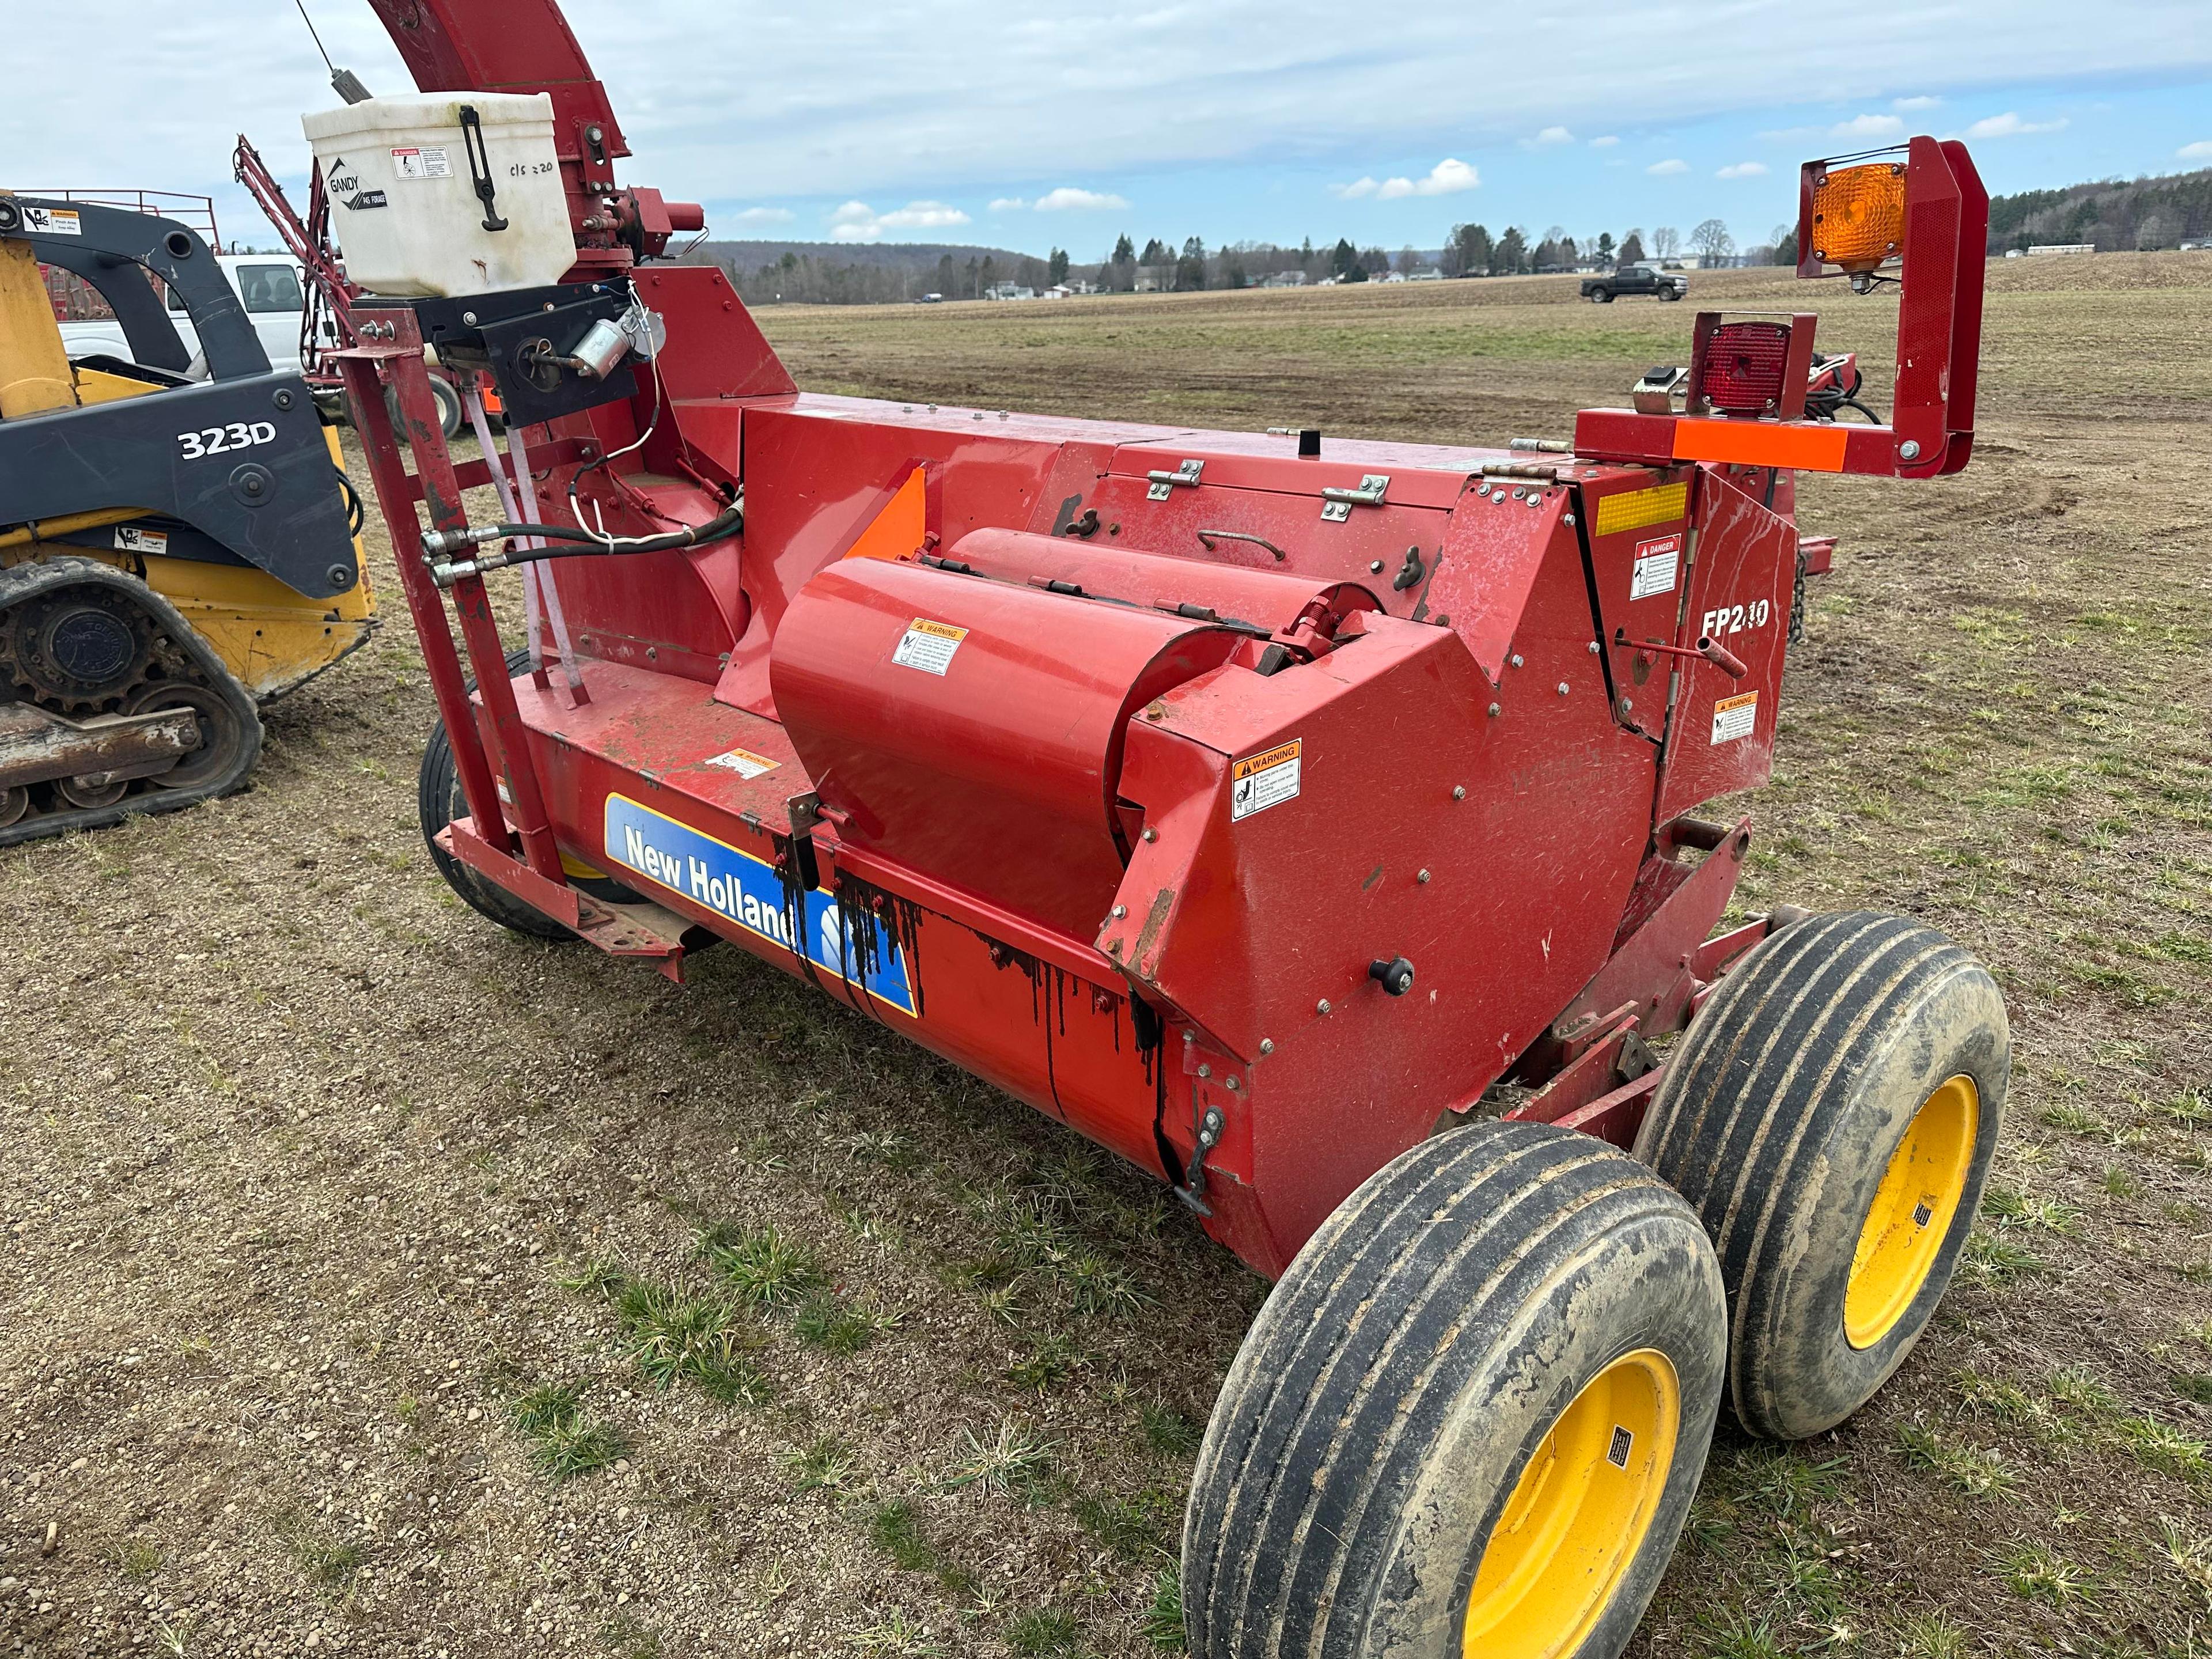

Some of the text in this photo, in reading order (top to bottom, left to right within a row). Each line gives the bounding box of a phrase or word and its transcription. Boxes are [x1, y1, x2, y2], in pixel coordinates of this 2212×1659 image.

[330, 176, 358, 192] GANDY
[371, 194, 386, 203] FORAGE
[177, 422, 276, 460] 323D
[1650, 541, 1674, 554] DANGER
[927, 624, 957, 638] WARNING
[1728, 696, 1752, 708] WARNING
[1253, 747, 1295, 770] WARNING
[624, 824, 797, 947] New Holland
